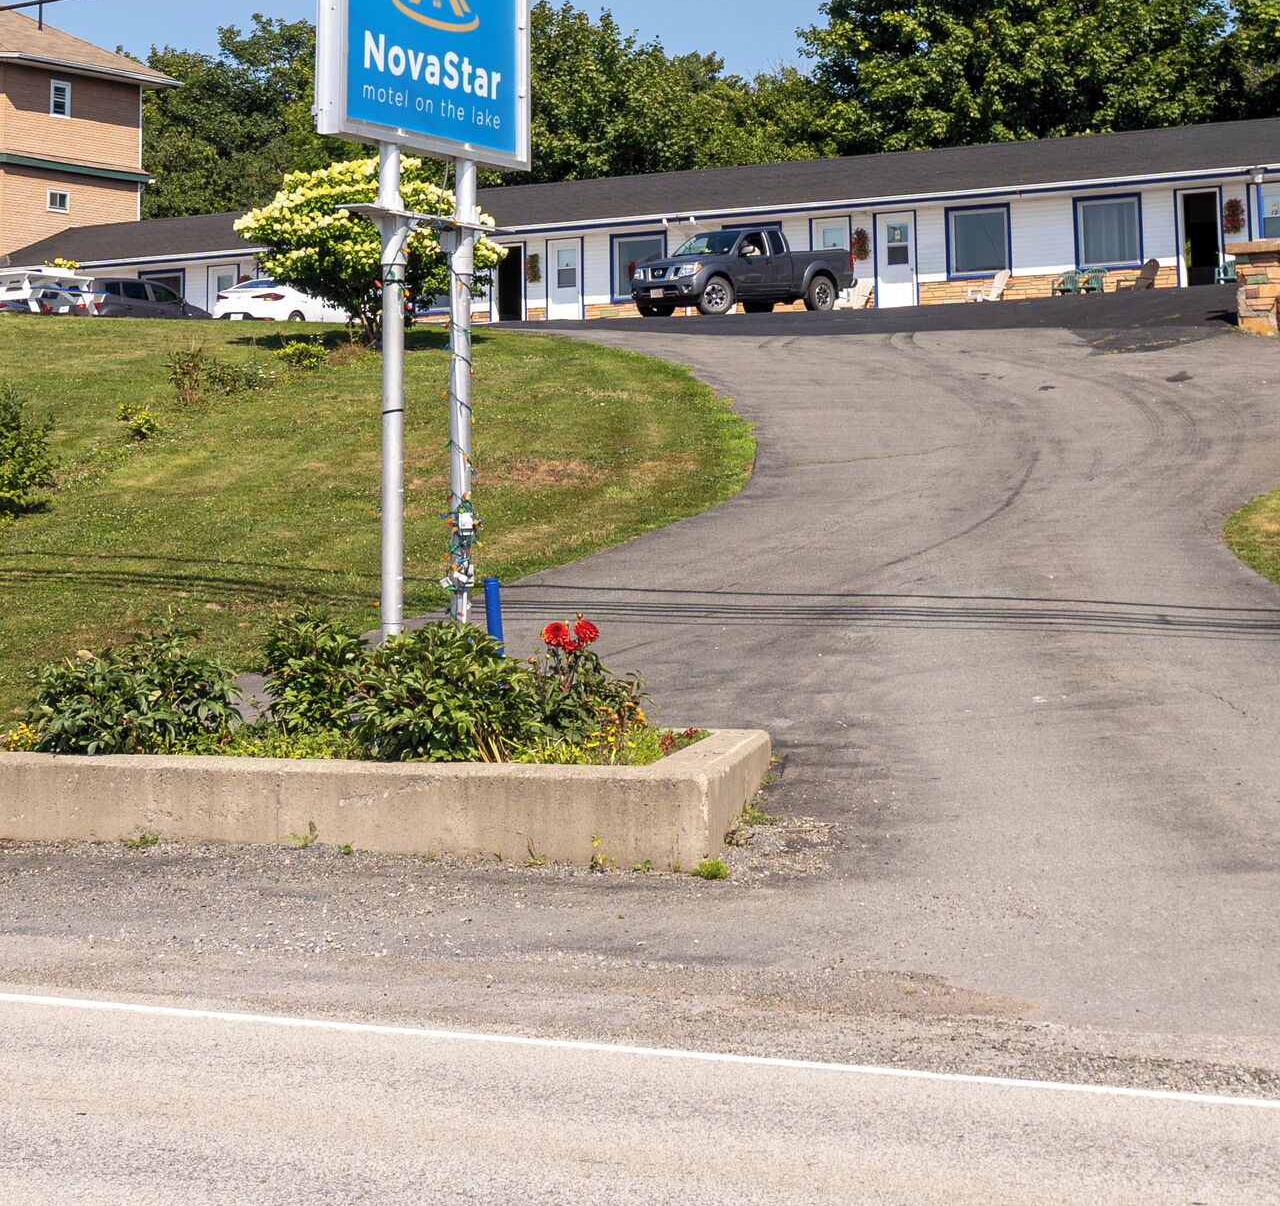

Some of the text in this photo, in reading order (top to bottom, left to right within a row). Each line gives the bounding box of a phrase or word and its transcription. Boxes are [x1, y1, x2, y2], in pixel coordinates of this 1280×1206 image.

[364, 30, 501, 100] NovaStar
[363, 84, 501, 129] motel on the lake
